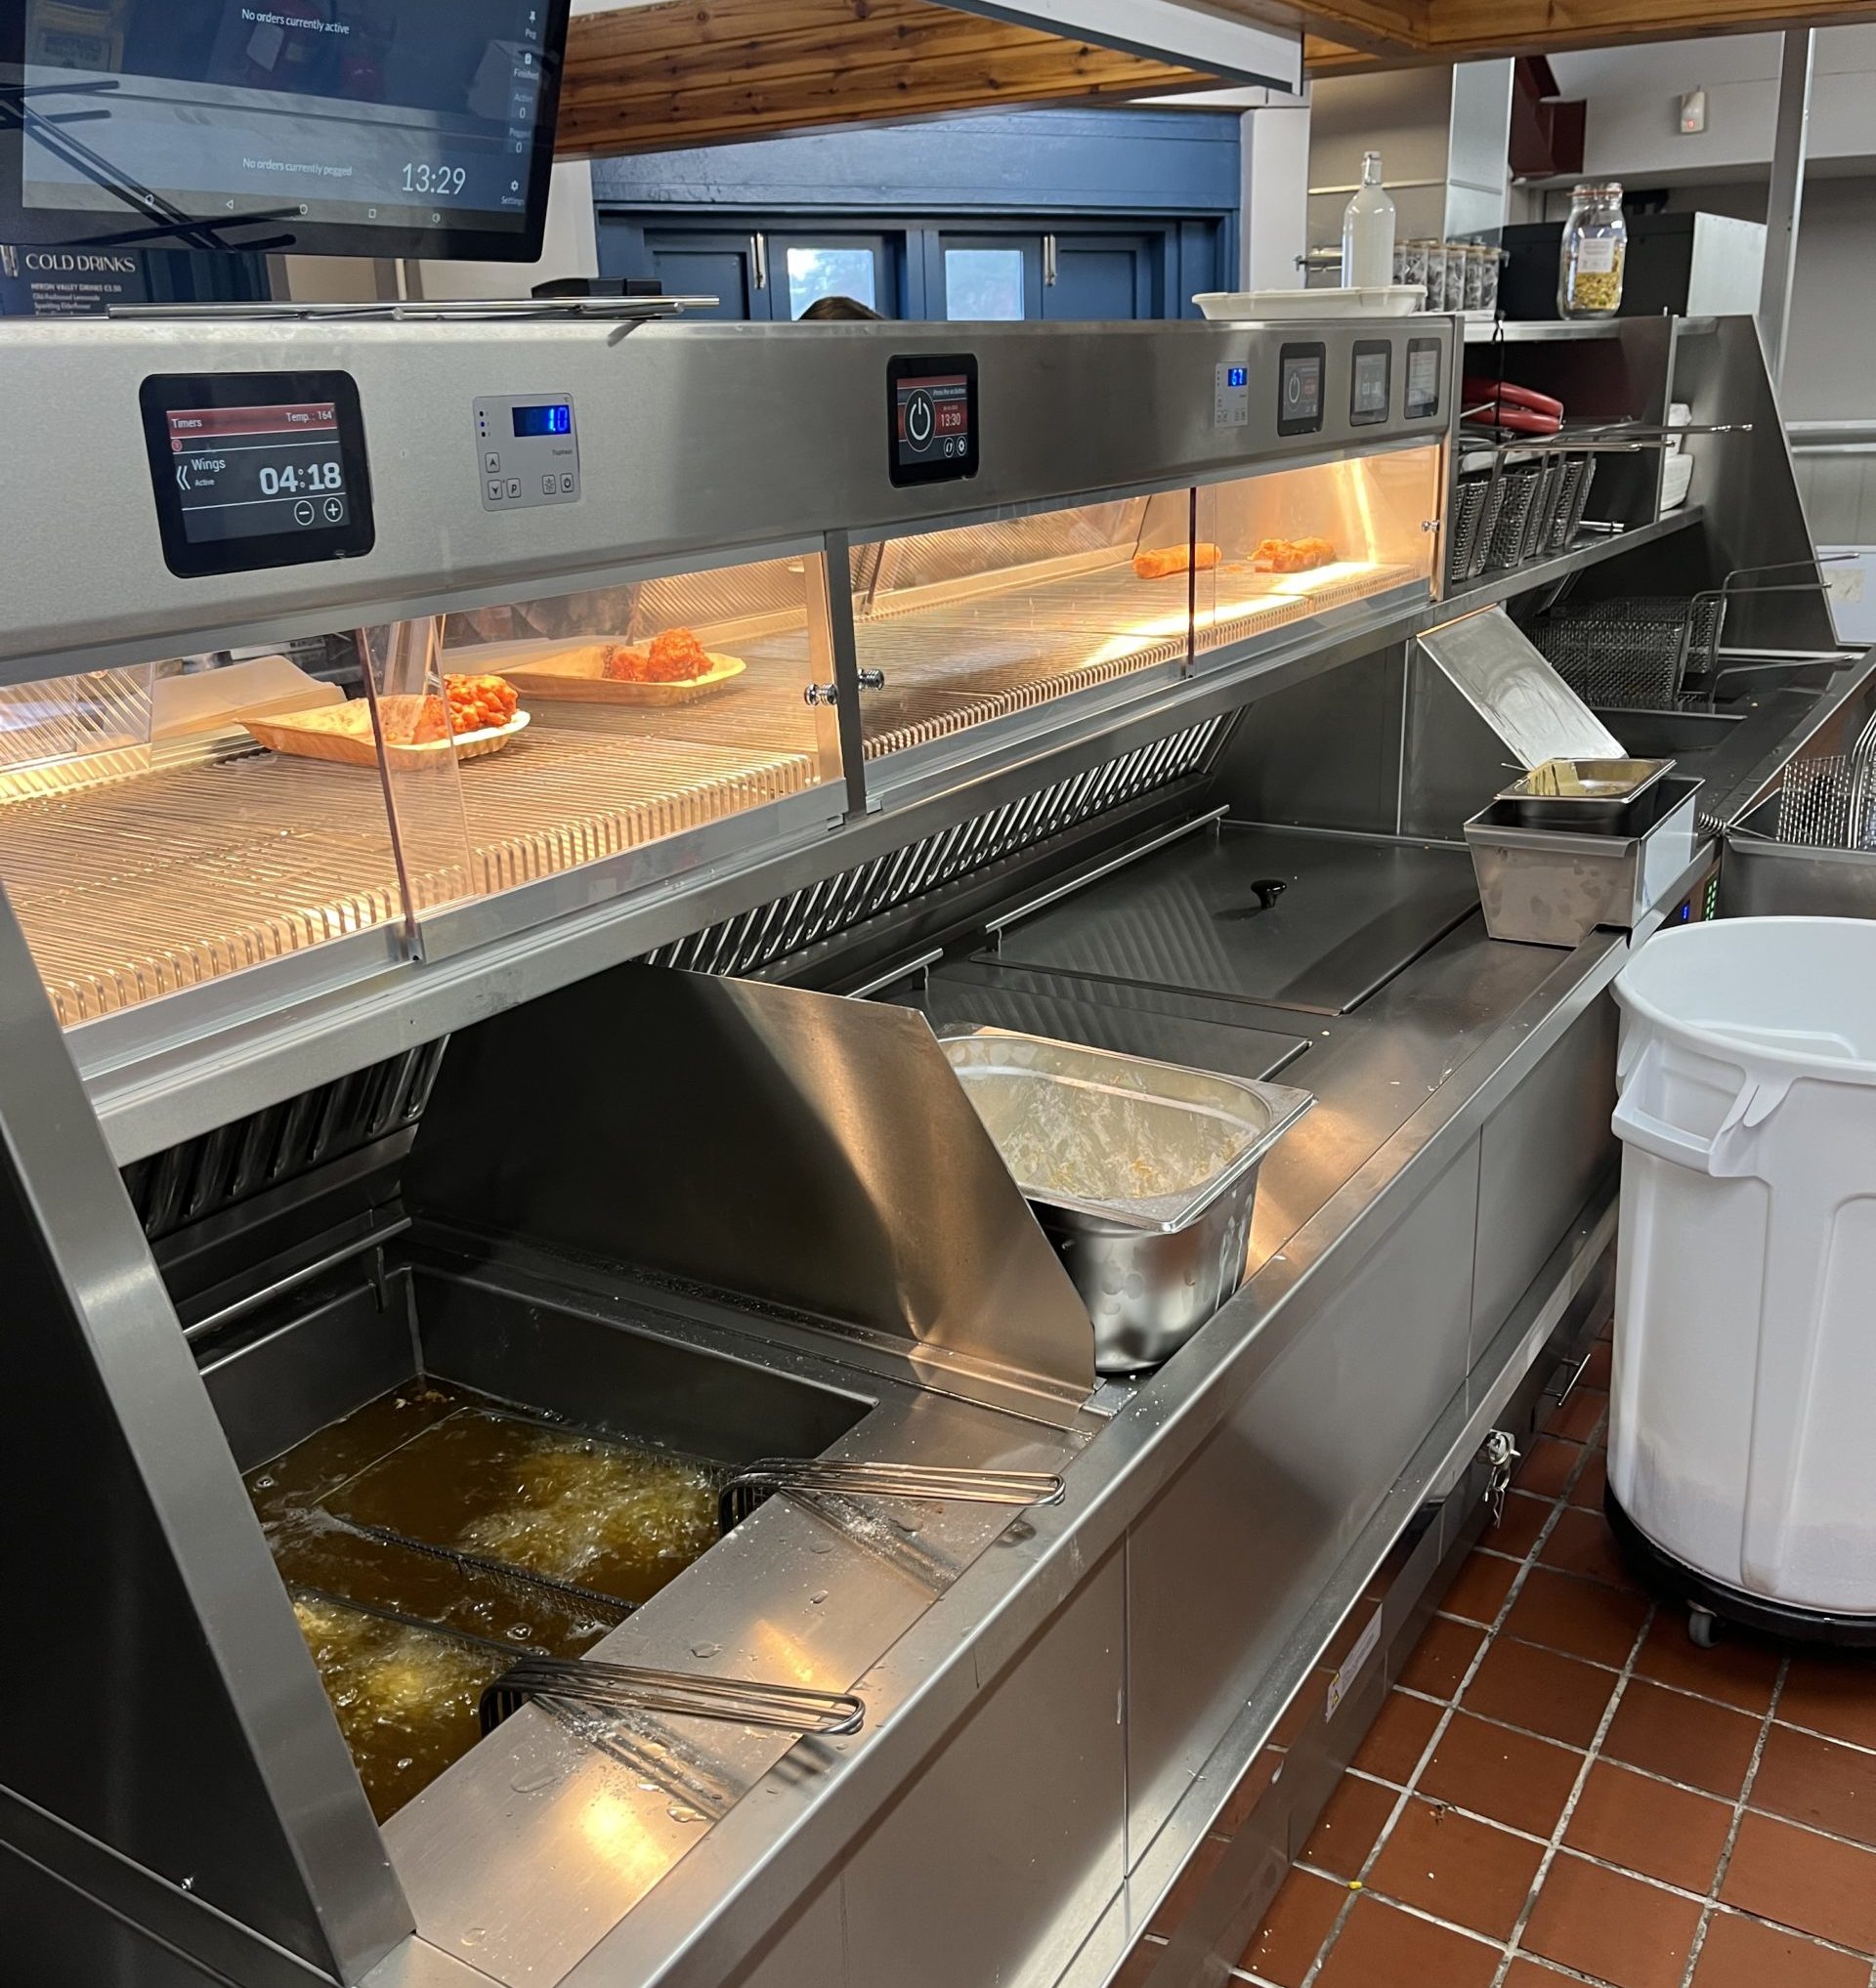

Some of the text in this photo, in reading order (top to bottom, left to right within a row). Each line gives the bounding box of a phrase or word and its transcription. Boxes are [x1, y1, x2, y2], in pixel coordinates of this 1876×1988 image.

[242, 8, 350, 34] No orders currently active
[519, 106, 527, 119] 0
[515, 142, 523, 153] 0
[242, 158, 353, 178] No orders currently pegged
[401, 162, 466, 195] 13:29
[25, 253, 136, 273] COLD DRINKS
[171, 418, 203, 430] Timers
[318, 410, 332, 421] 164
[940, 412, 961, 428] 13:30
[191, 457, 227, 473] Wings
[194, 478, 215, 486] Active
[259, 461, 342, 495] 04:18
